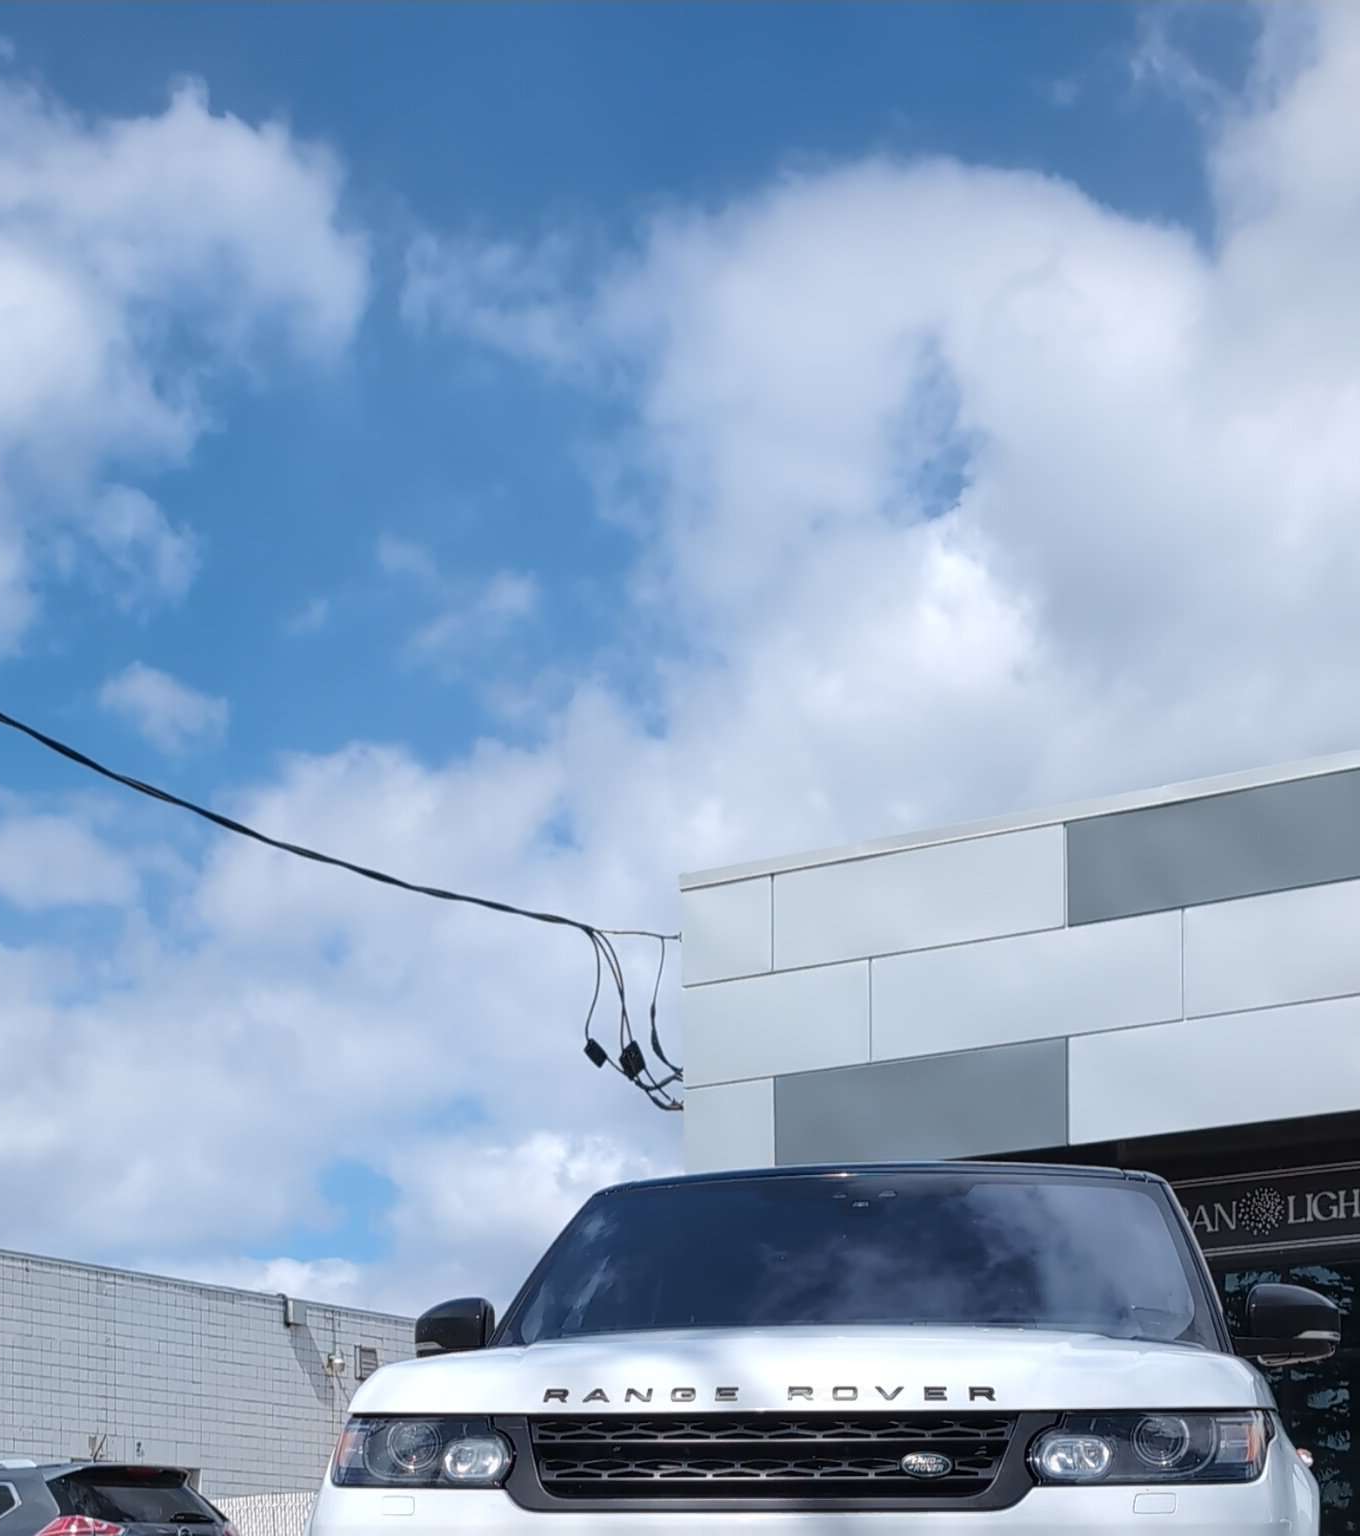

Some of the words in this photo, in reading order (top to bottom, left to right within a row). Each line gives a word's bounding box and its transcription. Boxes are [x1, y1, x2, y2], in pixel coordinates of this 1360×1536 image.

[1183, 1200, 1237, 1232] AN
[543, 1387, 739, 1403] RANGE
[787, 1385, 997, 1402] ROVER
